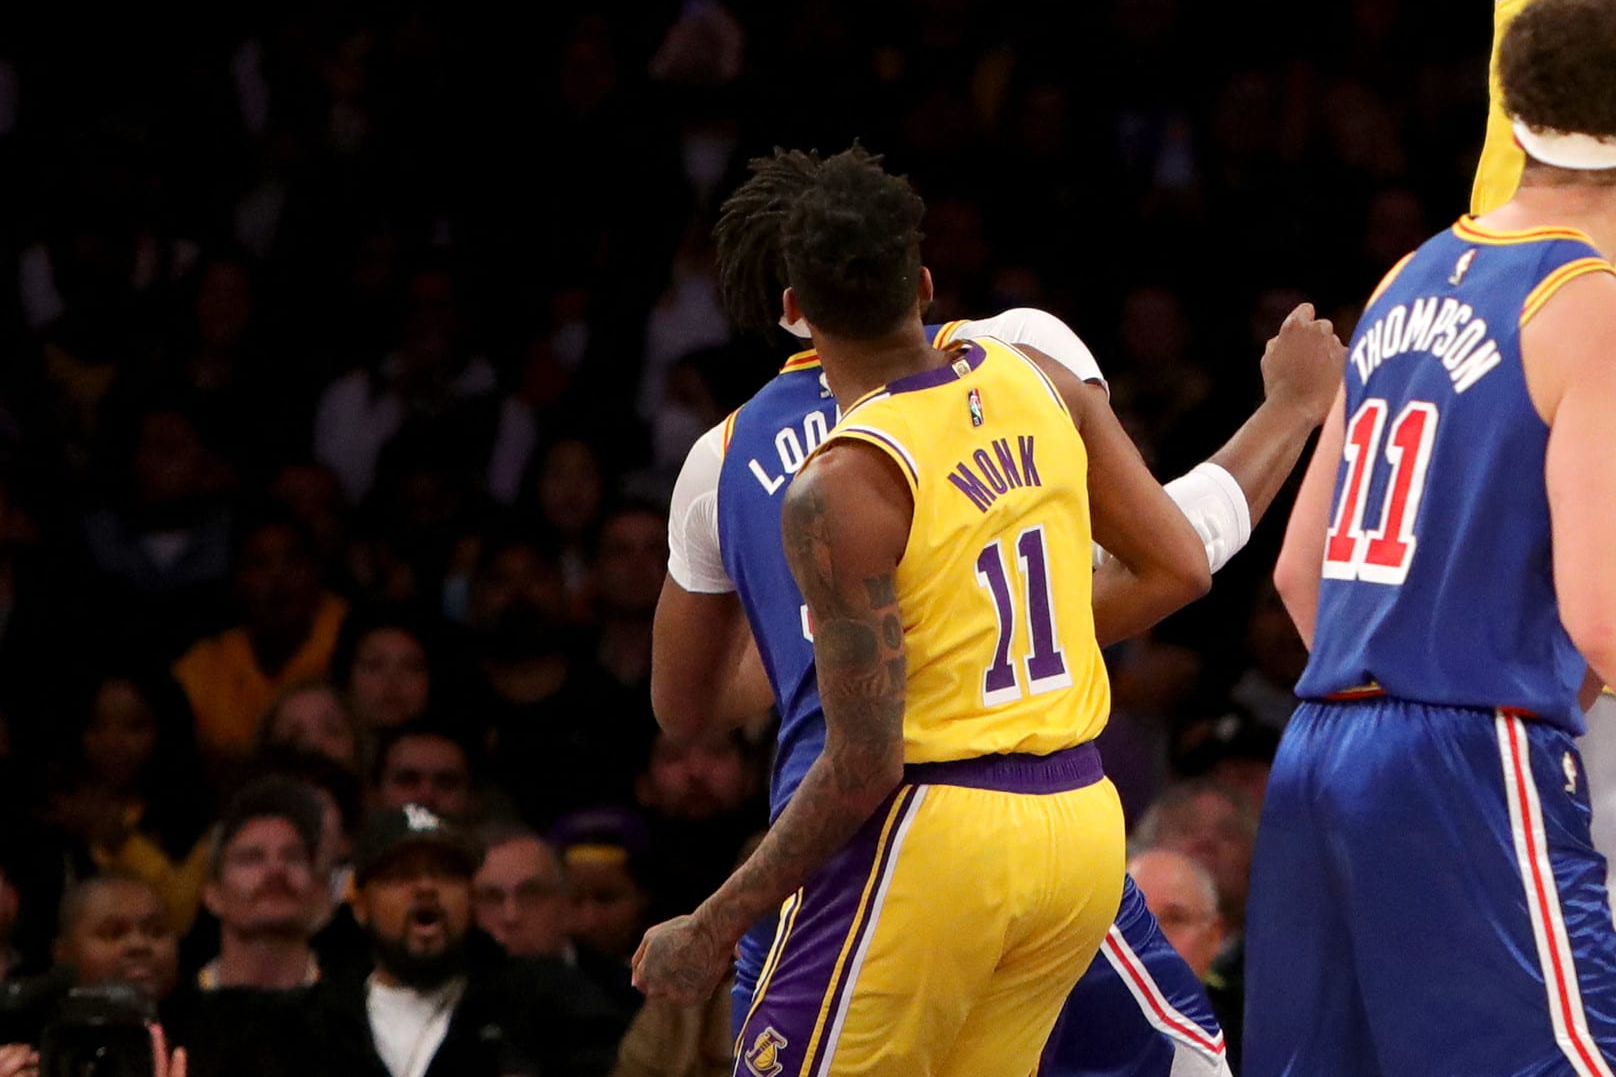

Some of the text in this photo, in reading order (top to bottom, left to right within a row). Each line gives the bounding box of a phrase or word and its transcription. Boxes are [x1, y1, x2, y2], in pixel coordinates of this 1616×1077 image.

[1351, 297, 1501, 394] THOMPSON
[748, 404, 842, 496] LOO
[947, 435, 1041, 514] MONK
[1321, 398, 1439, 585] 11
[974, 523, 1073, 708] 11
